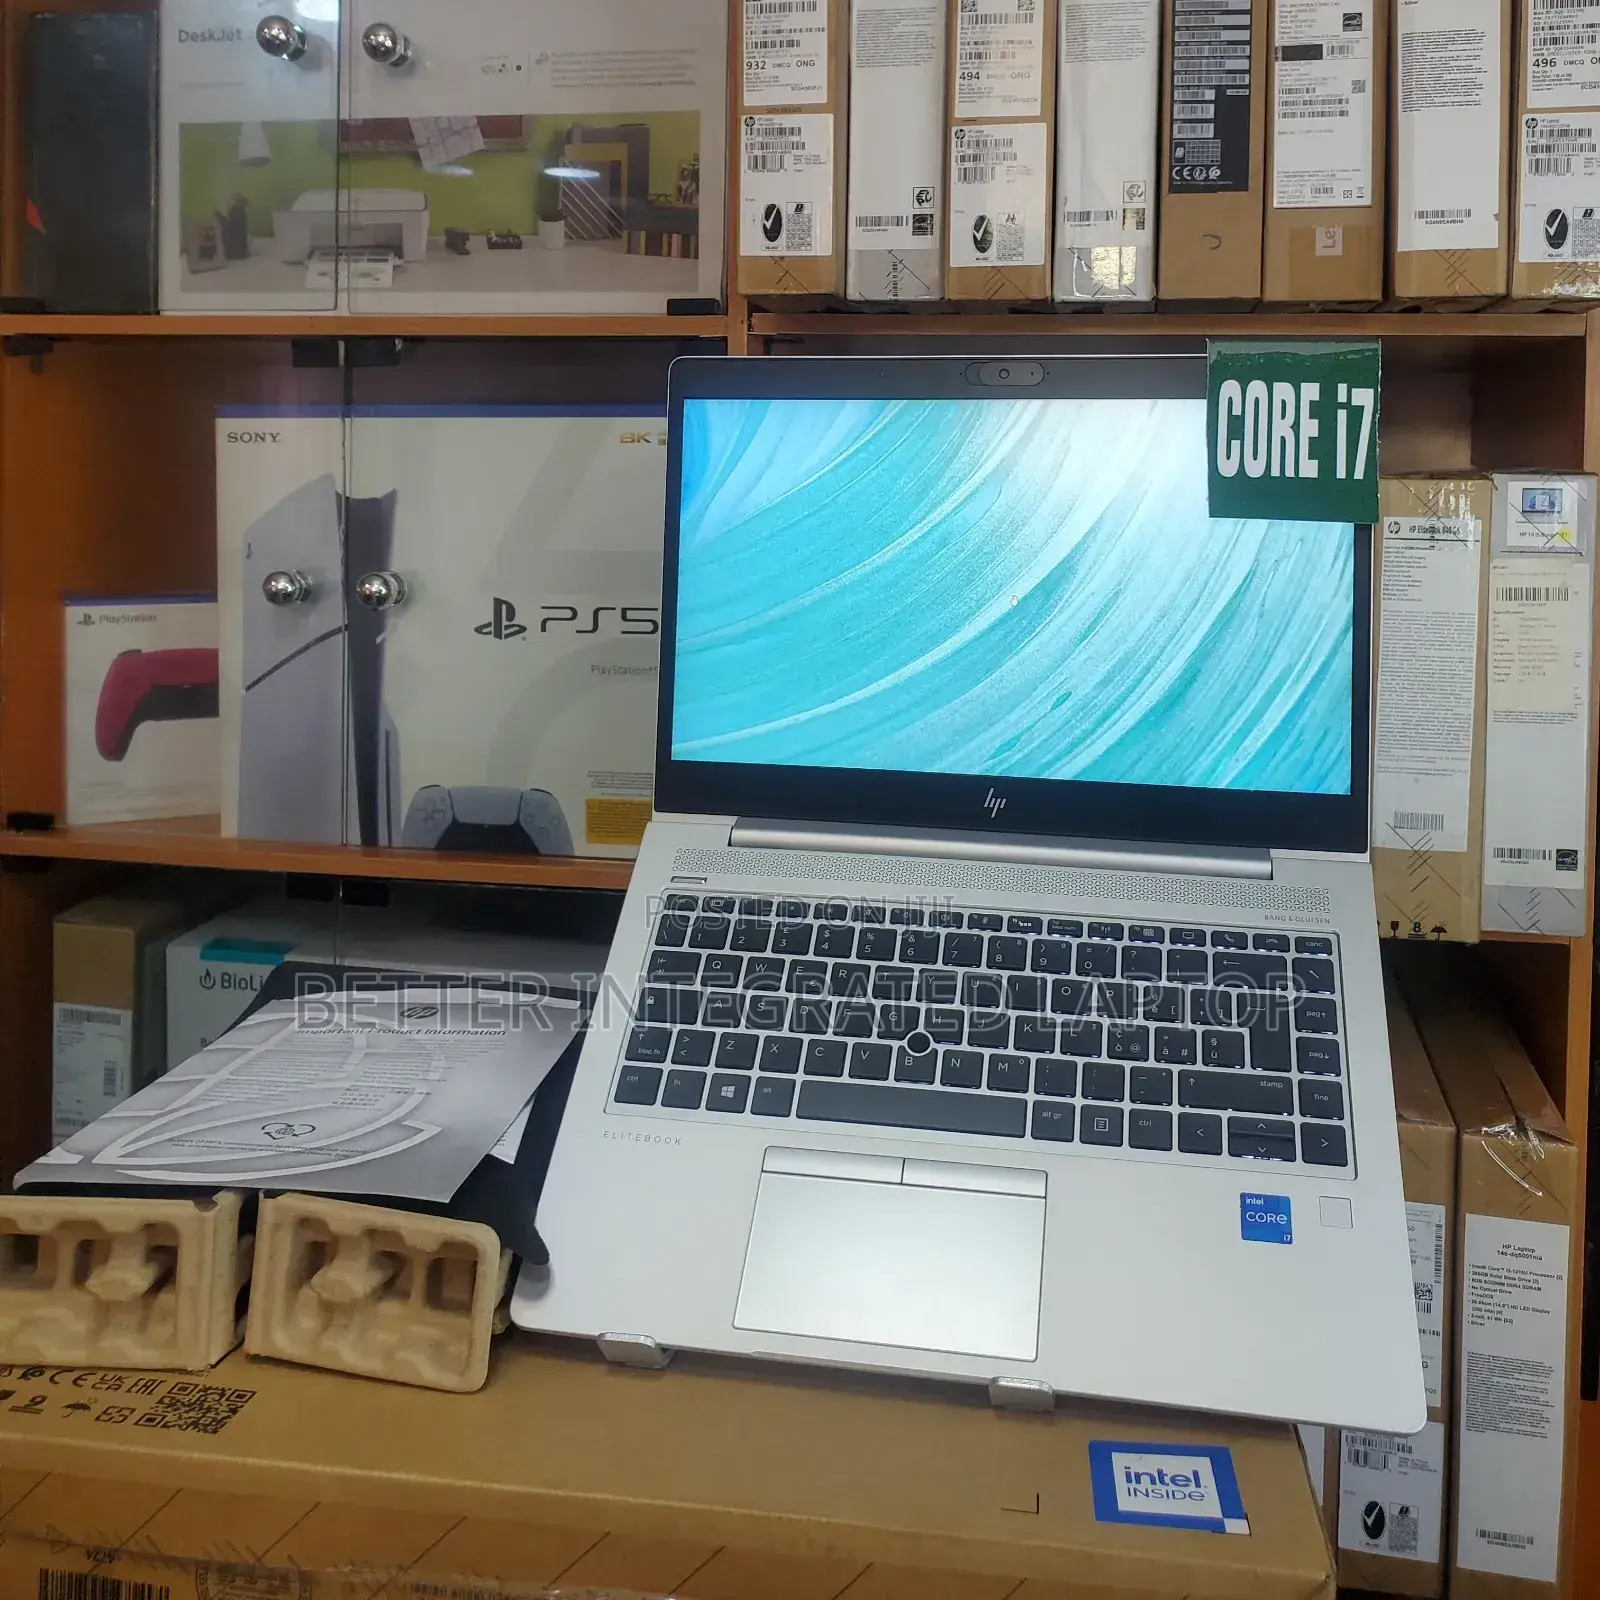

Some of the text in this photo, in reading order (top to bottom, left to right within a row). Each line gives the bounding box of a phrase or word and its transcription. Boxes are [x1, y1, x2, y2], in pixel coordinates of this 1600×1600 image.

[178, 28, 243, 43] DeskJet
[746, 60, 767, 70] 932
[796, 60, 816, 68] ONG
[1532, 58, 1557, 68] 496
[959, 72, 980, 81] 494
[1216, 380, 1375, 480] CORE i7
[228, 432, 281, 444] SONY
[620, 432, 652, 444] 8K
[1408, 526, 1417, 534] HP
[99, 613, 157, 625] PlayStation
[540, 606, 659, 635] PS5
[984, 788, 1007, 818] hp
[1264, 914, 1286, 922] BANG
[1295, 916, 1331, 924] OLUFSEN
[824, 929, 830, 938] $
[866, 933, 875, 941] %
[908, 935, 916, 943] &
[738, 936, 745, 944] 2
[780, 939, 787, 947] 3
[822, 942, 829, 950] 4
[908, 948, 915, 956] 6
[952, 951, 958, 959] 7
[996, 954, 1003, 962] 8
[1040, 958, 1047, 966] 9
[712, 961, 722, 970] Q
[755, 963, 768, 972] W
[796, 966, 804, 975] E
[838, 970, 848, 978] R
[882, 972, 890, 981] T
[928, 976, 936, 985] Y
[1062, 986, 1072, 996] O
[714, 1000, 723, 1008] A
[757, 1003, 765, 1012] S
[800, 1006, 809, 1015] D
[888, 1012, 898, 1021] G
[932, 1016, 942, 1025] H
[978, 1020, 985, 1028] J
[1024, 1023, 1033, 1033] K
[1070, 1027, 1078, 1037] L
[424, 1028, 507, 1036] Information
[638, 1047, 661, 1056] bloc fn
[1130, 1043, 1141, 1052] @
[1181, 1048, 1189, 1057] #
[726, 1040, 1283, 1089] Z X C V B N M stamp
[674, 1078, 681, 1086] fn
[1042, 1110, 1052, 1118] alt
[1053, 1112, 1063, 1120] gr
[1139, 1119, 1152, 1127] ctrl
[603, 1130, 683, 1146] ELITEBOOK
[1245, 1196, 1264, 1206] intel
[1284, 1234, 1291, 1242] i7
[1514, 1245, 1536, 1253] Laptop
[1532, 1306, 1551, 1315] Display
